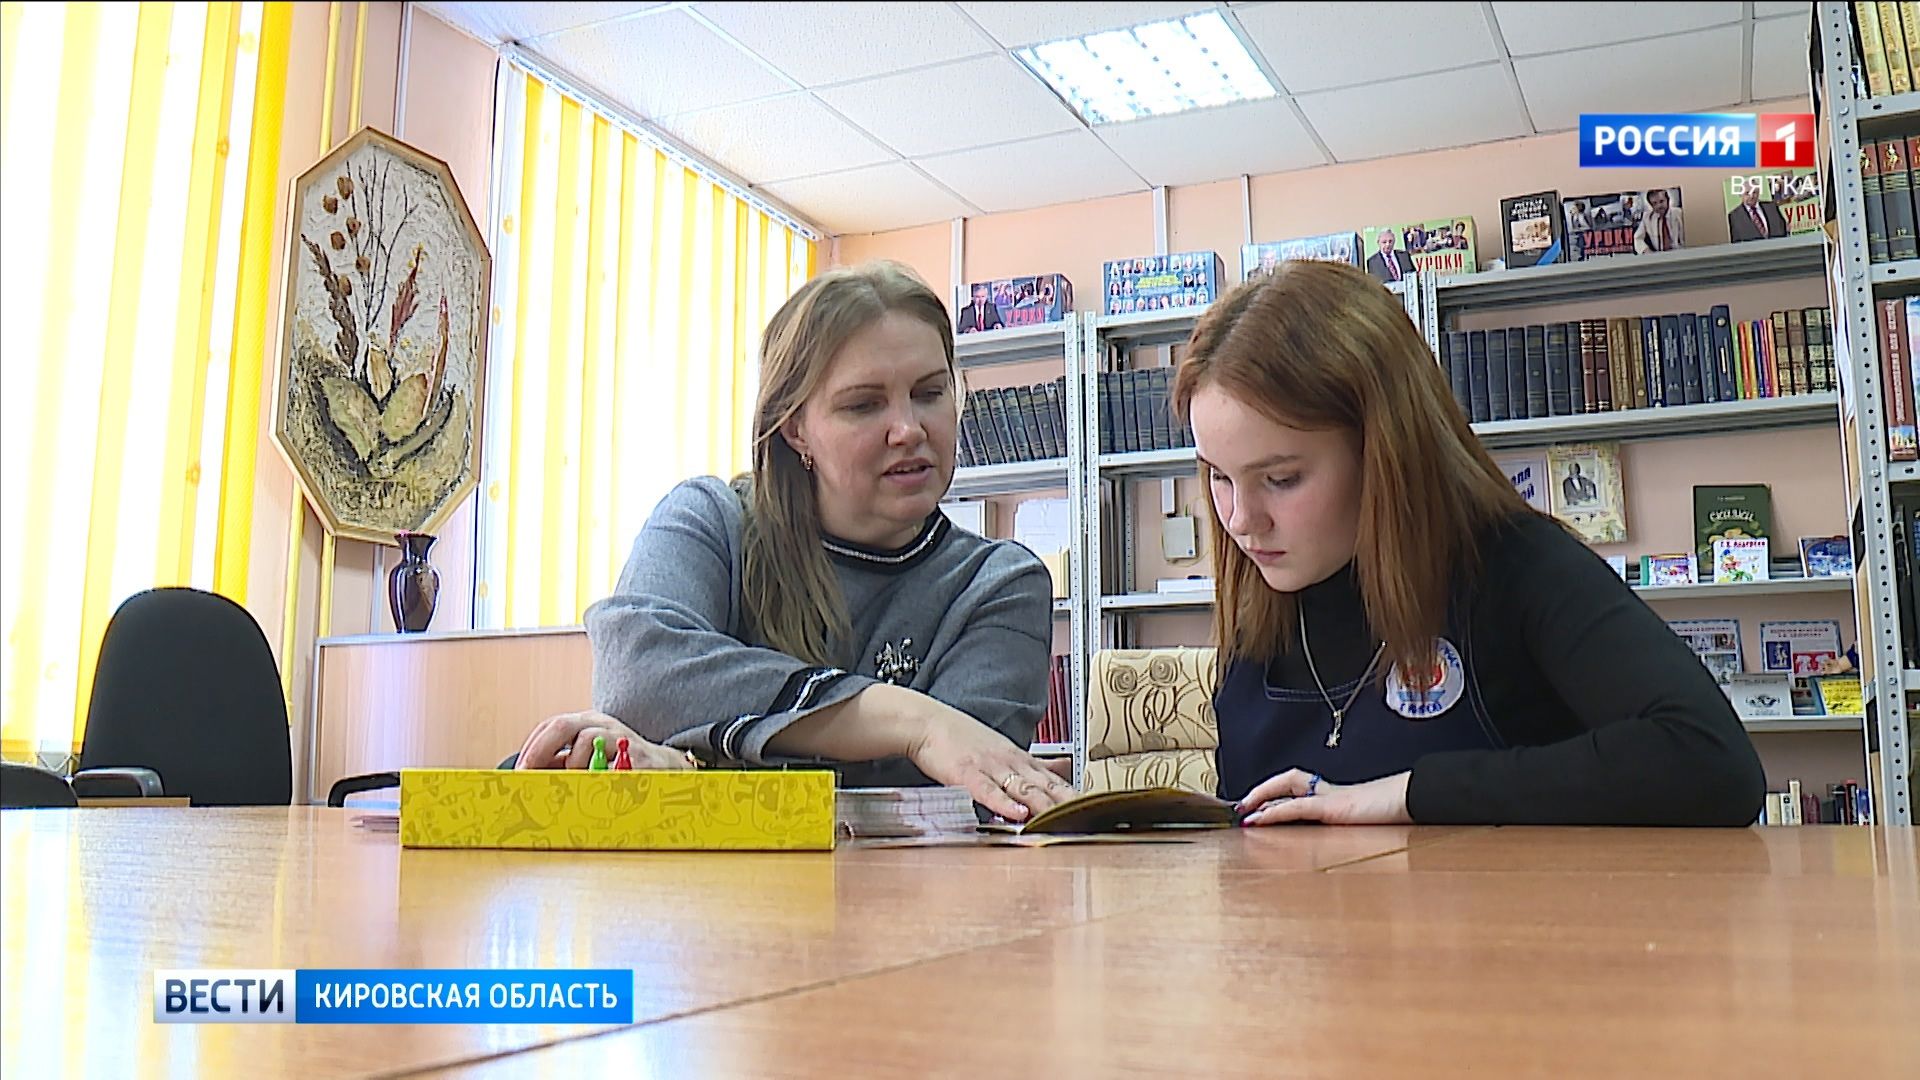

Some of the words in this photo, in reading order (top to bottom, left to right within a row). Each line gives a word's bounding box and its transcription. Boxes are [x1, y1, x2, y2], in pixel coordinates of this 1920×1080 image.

[1583, 228, 1634, 248] УРОКИ
[1416, 253, 1463, 273] УРОКИ
[1005, 306, 1045, 325] УРОКИ
